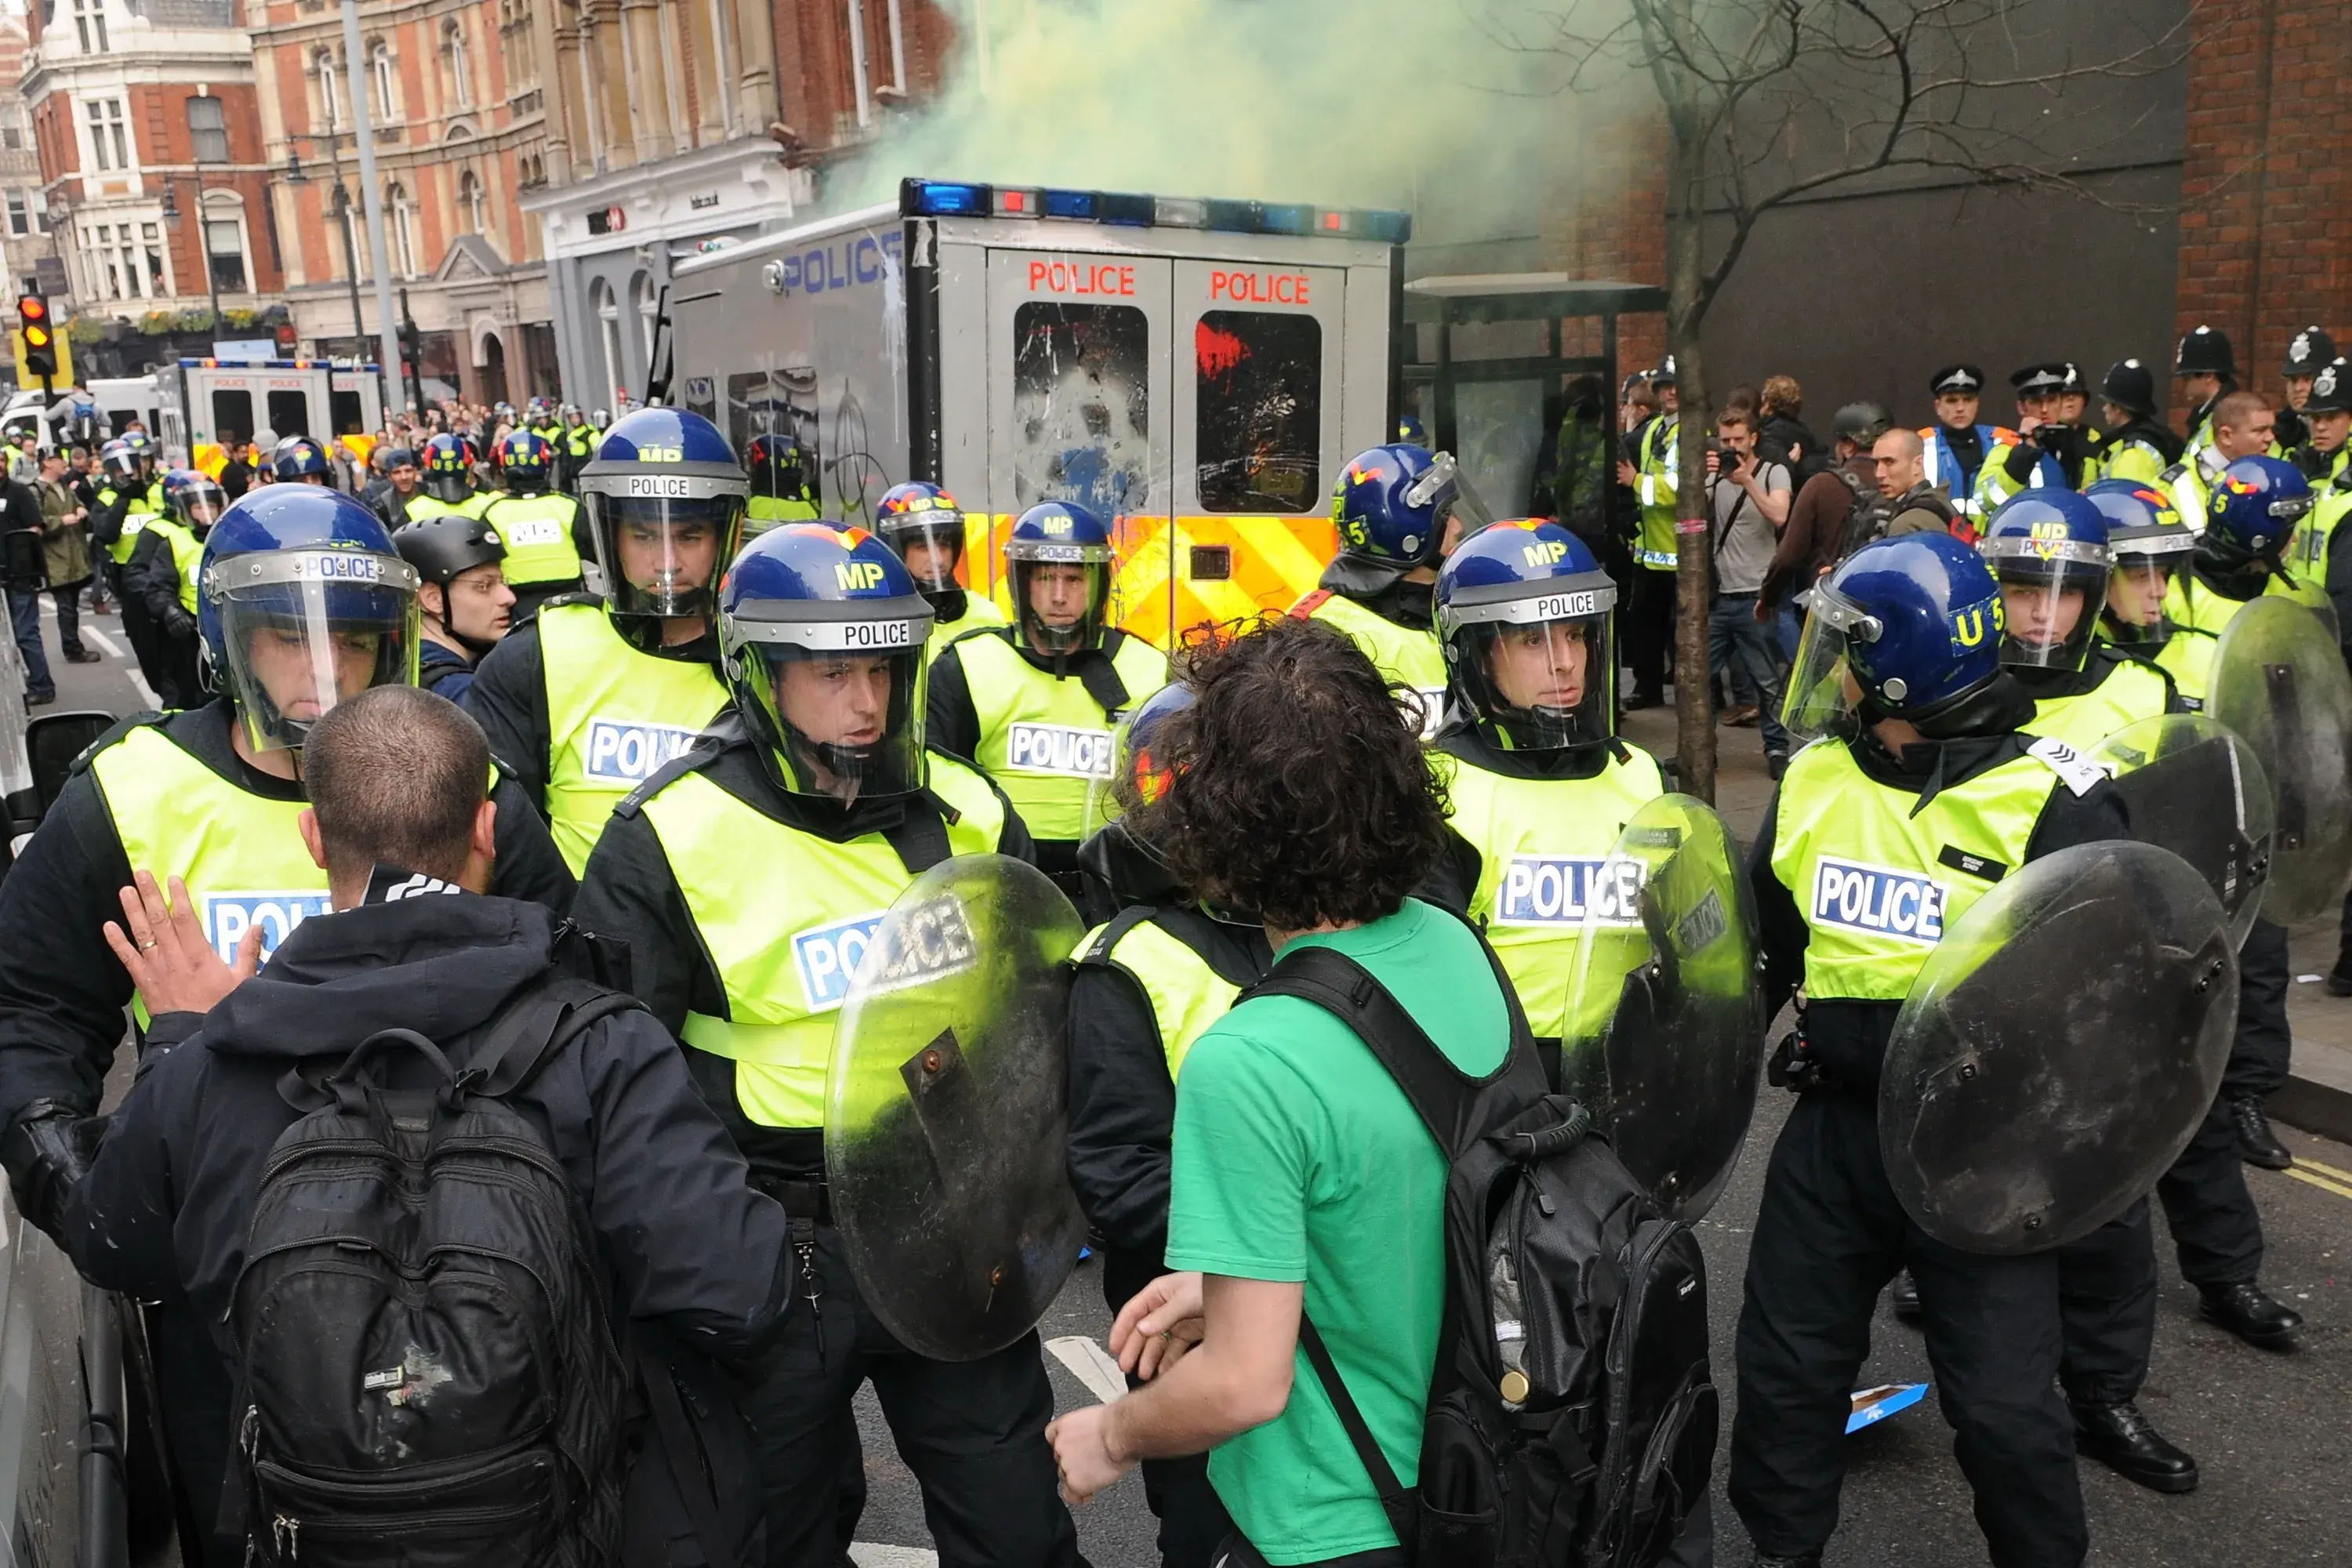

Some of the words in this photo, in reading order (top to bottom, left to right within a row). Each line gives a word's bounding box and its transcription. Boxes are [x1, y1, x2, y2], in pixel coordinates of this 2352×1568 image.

[784, 230, 902, 298] POLICE
[1029, 262, 1135, 296] POLICE
[1211, 271, 1310, 304] POLICE
[631, 478, 688, 495] POLICE
[1044, 516, 1073, 534] MP
[2031, 521, 2067, 539] MP
[1040, 546, 1079, 559] POLICE
[1523, 542, 1568, 568] MP
[2024, 540, 2072, 557] POCE
[305, 557, 376, 579] POLICE
[833, 563, 884, 591] MP
[1537, 594, 1594, 617] POLICE
[844, 623, 908, 646] POLICE
[1013, 728, 1110, 772] POLICE
[1504, 863, 1639, 918] POLICE
[1818, 866, 1941, 938] POLICE
[803, 905, 969, 998] POLICE
